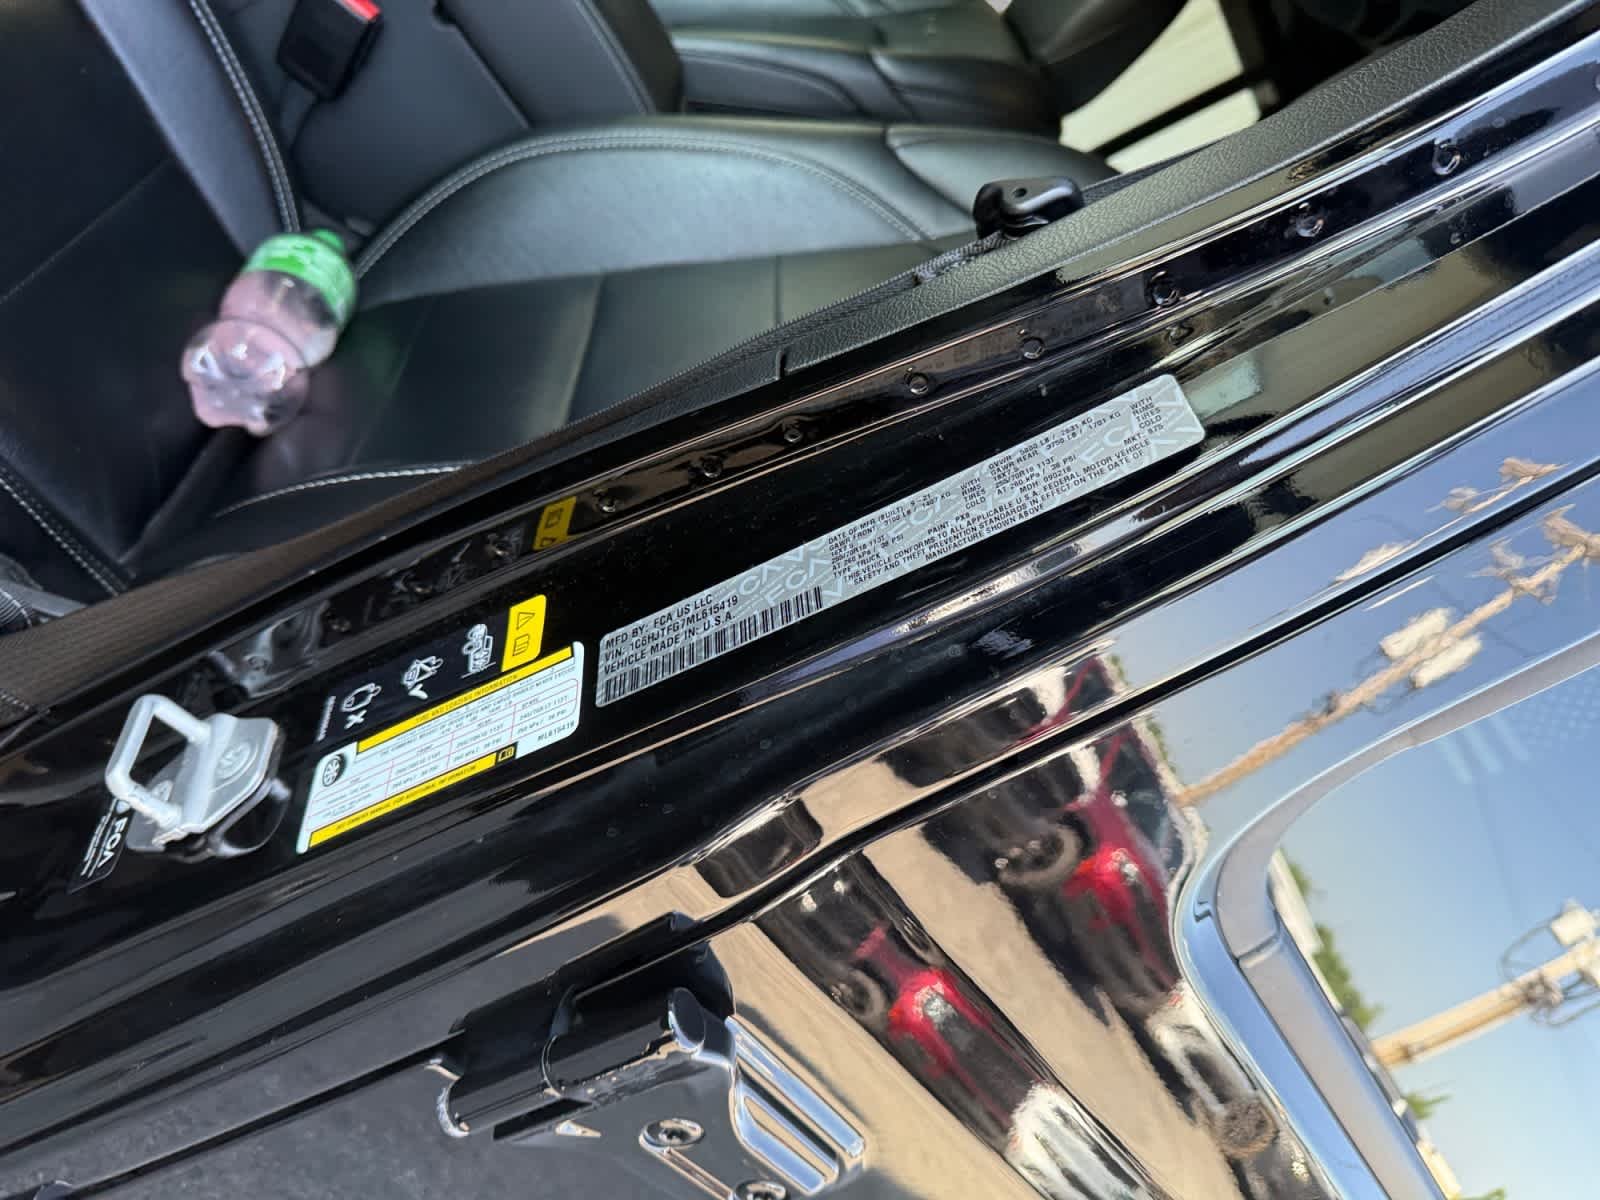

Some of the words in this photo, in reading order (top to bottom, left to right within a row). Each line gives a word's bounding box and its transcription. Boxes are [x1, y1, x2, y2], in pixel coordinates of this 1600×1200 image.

[1128, 395, 1153, 410] WITH
[1135, 406, 1161, 422] TIRES
[1137, 413, 1162, 429] COLD
[989, 459, 1015, 476] GAWR
[959, 476, 980, 490] WITH
[963, 487, 986, 503] TIRES
[964, 495, 986, 510] COLD
[861, 555, 891, 574] VEHICLE
[893, 535, 936, 560] CONFORMS
[949, 522, 964, 535] ALL
[965, 500, 1013, 527] APPLICABLE
[1041, 470, 1081, 493] FEDERAL
[1081, 455, 1114, 475] MOTOR
[1114, 438, 1151, 460] VEHICLE
[853, 567, 882, 586] SAFETY
[883, 558, 900, 572] AND
[902, 547, 925, 564] THEFT
[927, 524, 977, 552] PREVENTION
[977, 501, 1028, 529] STANDARDS
[1086, 467, 1104, 480] THE
[1106, 455, 1131, 471] DATE
[827, 530, 846, 544] DATE
[924, 528, 985, 561] MANUFACTURE
[984, 515, 1016, 535] SHOWN
[1016, 502, 1044, 520] ABOVE
[856, 552, 880, 568] TRUCK
[605, 630, 628, 650] MFD
[631, 621, 648, 638] BY:
[653, 610, 672, 628] FCA
[676, 602, 690, 618] US
[694, 592, 712, 610] LLC
[603, 647, 646, 677] VEHICLE
[649, 632, 680, 656] MADE
[683, 624, 698, 641] IN:
[702, 608, 735, 632] U.S.A.
[604, 644, 624, 663] VIN:
